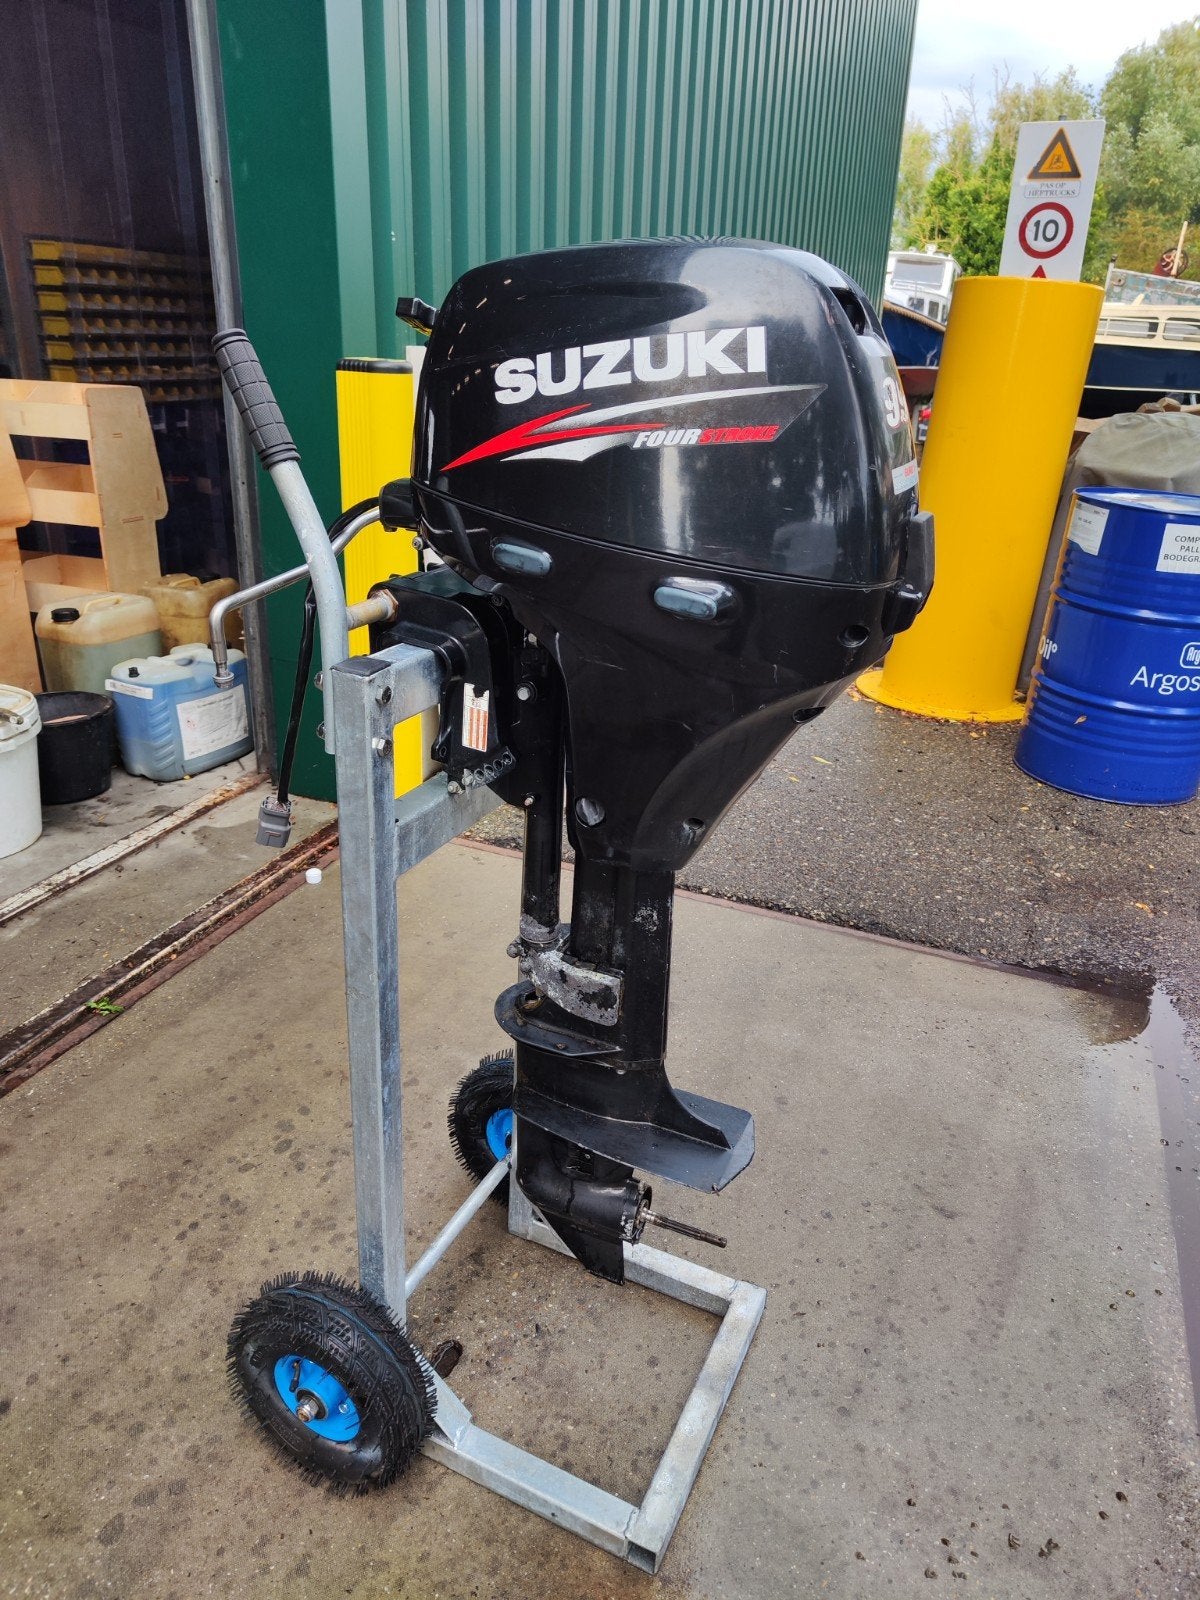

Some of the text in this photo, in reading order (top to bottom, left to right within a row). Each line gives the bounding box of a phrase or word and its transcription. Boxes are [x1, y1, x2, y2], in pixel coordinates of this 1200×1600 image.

[1033, 219, 1059, 242] 10
[493, 325, 767, 405] SUZUKI
[1174, 535, 1200, 544] COMP
[1163, 553, 1200, 563] BODEGR
